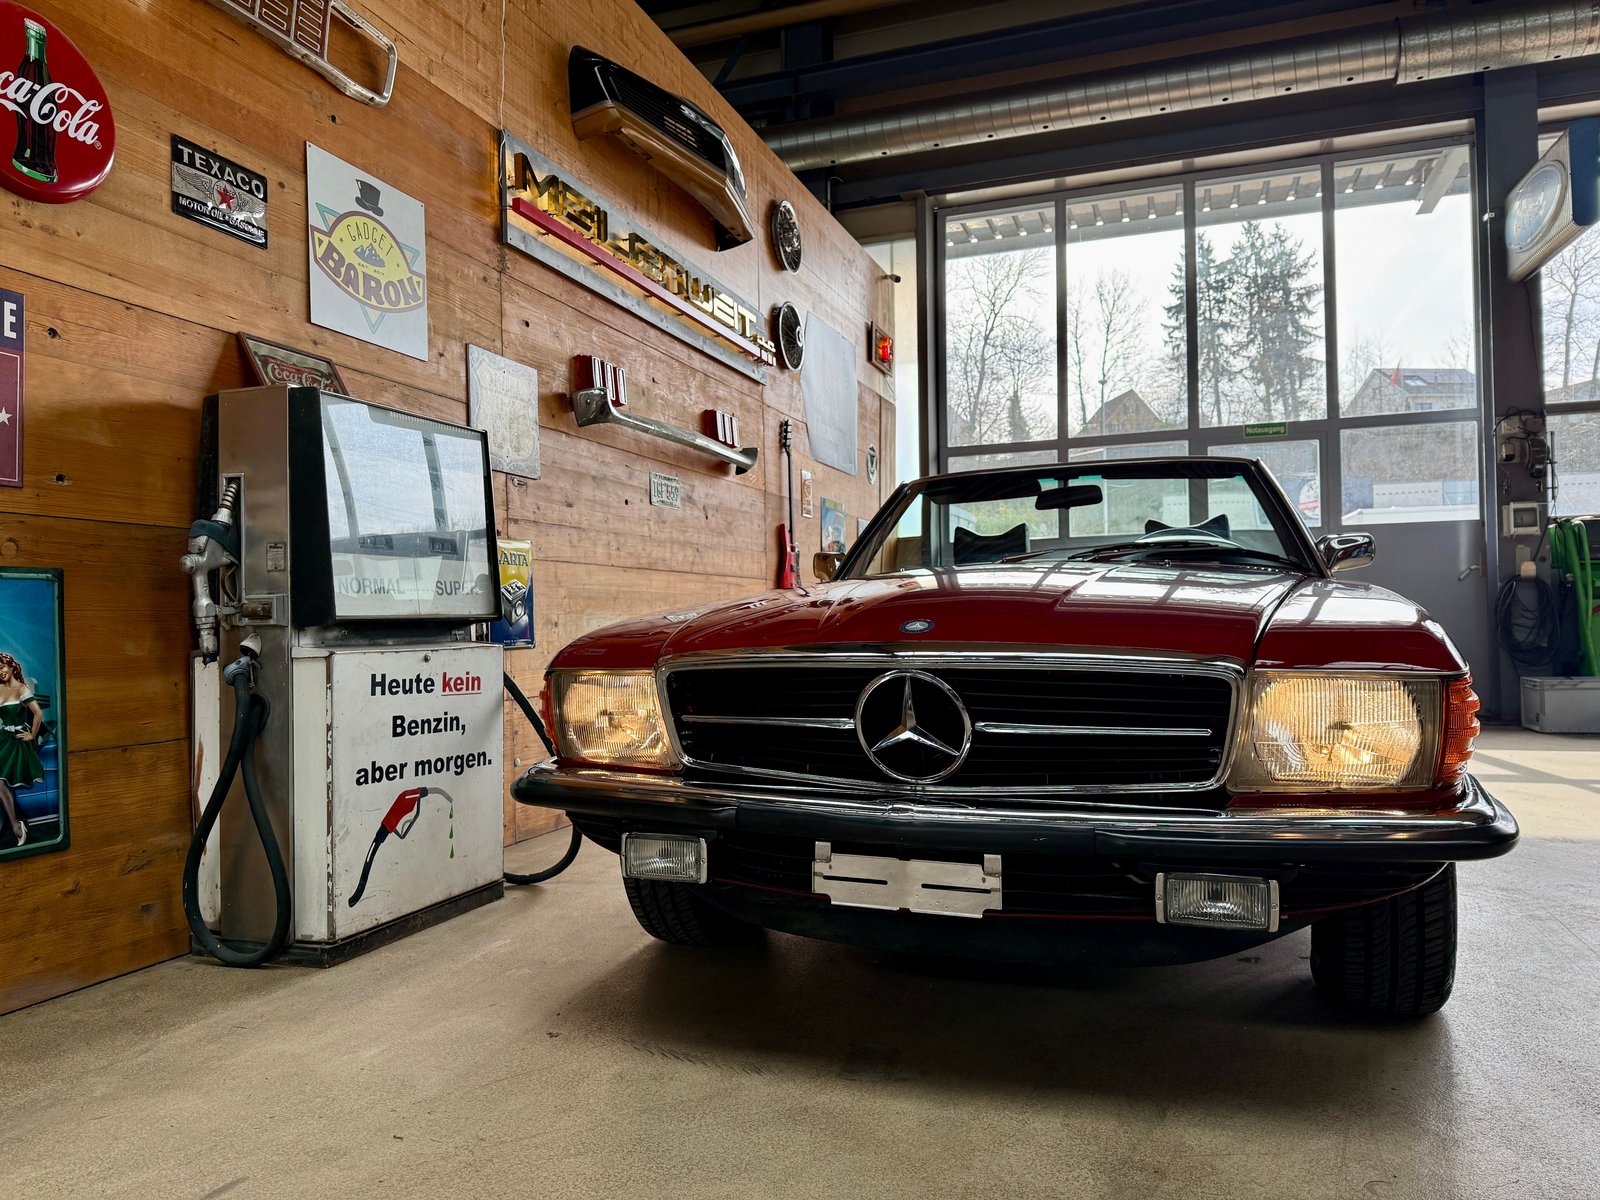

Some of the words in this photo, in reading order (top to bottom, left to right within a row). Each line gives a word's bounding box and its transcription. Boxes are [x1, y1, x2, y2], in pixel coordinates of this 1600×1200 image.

[0, 71, 103, 145] ca-Cola
[178, 144, 264, 199] TEXACO
[179, 195, 210, 216] MOTOR
[346, 222, 394, 257] GADGET
[318, 240, 421, 307] BARON
[499, 549, 528, 566] ARTA
[339, 577, 406, 595] NORMAL
[371, 672, 435, 696] Heute
[442, 671, 482, 693] kein
[392, 711, 466, 738] Benzin,
[356, 761, 408, 786] aber
[415, 751, 492, 776] morgen.
